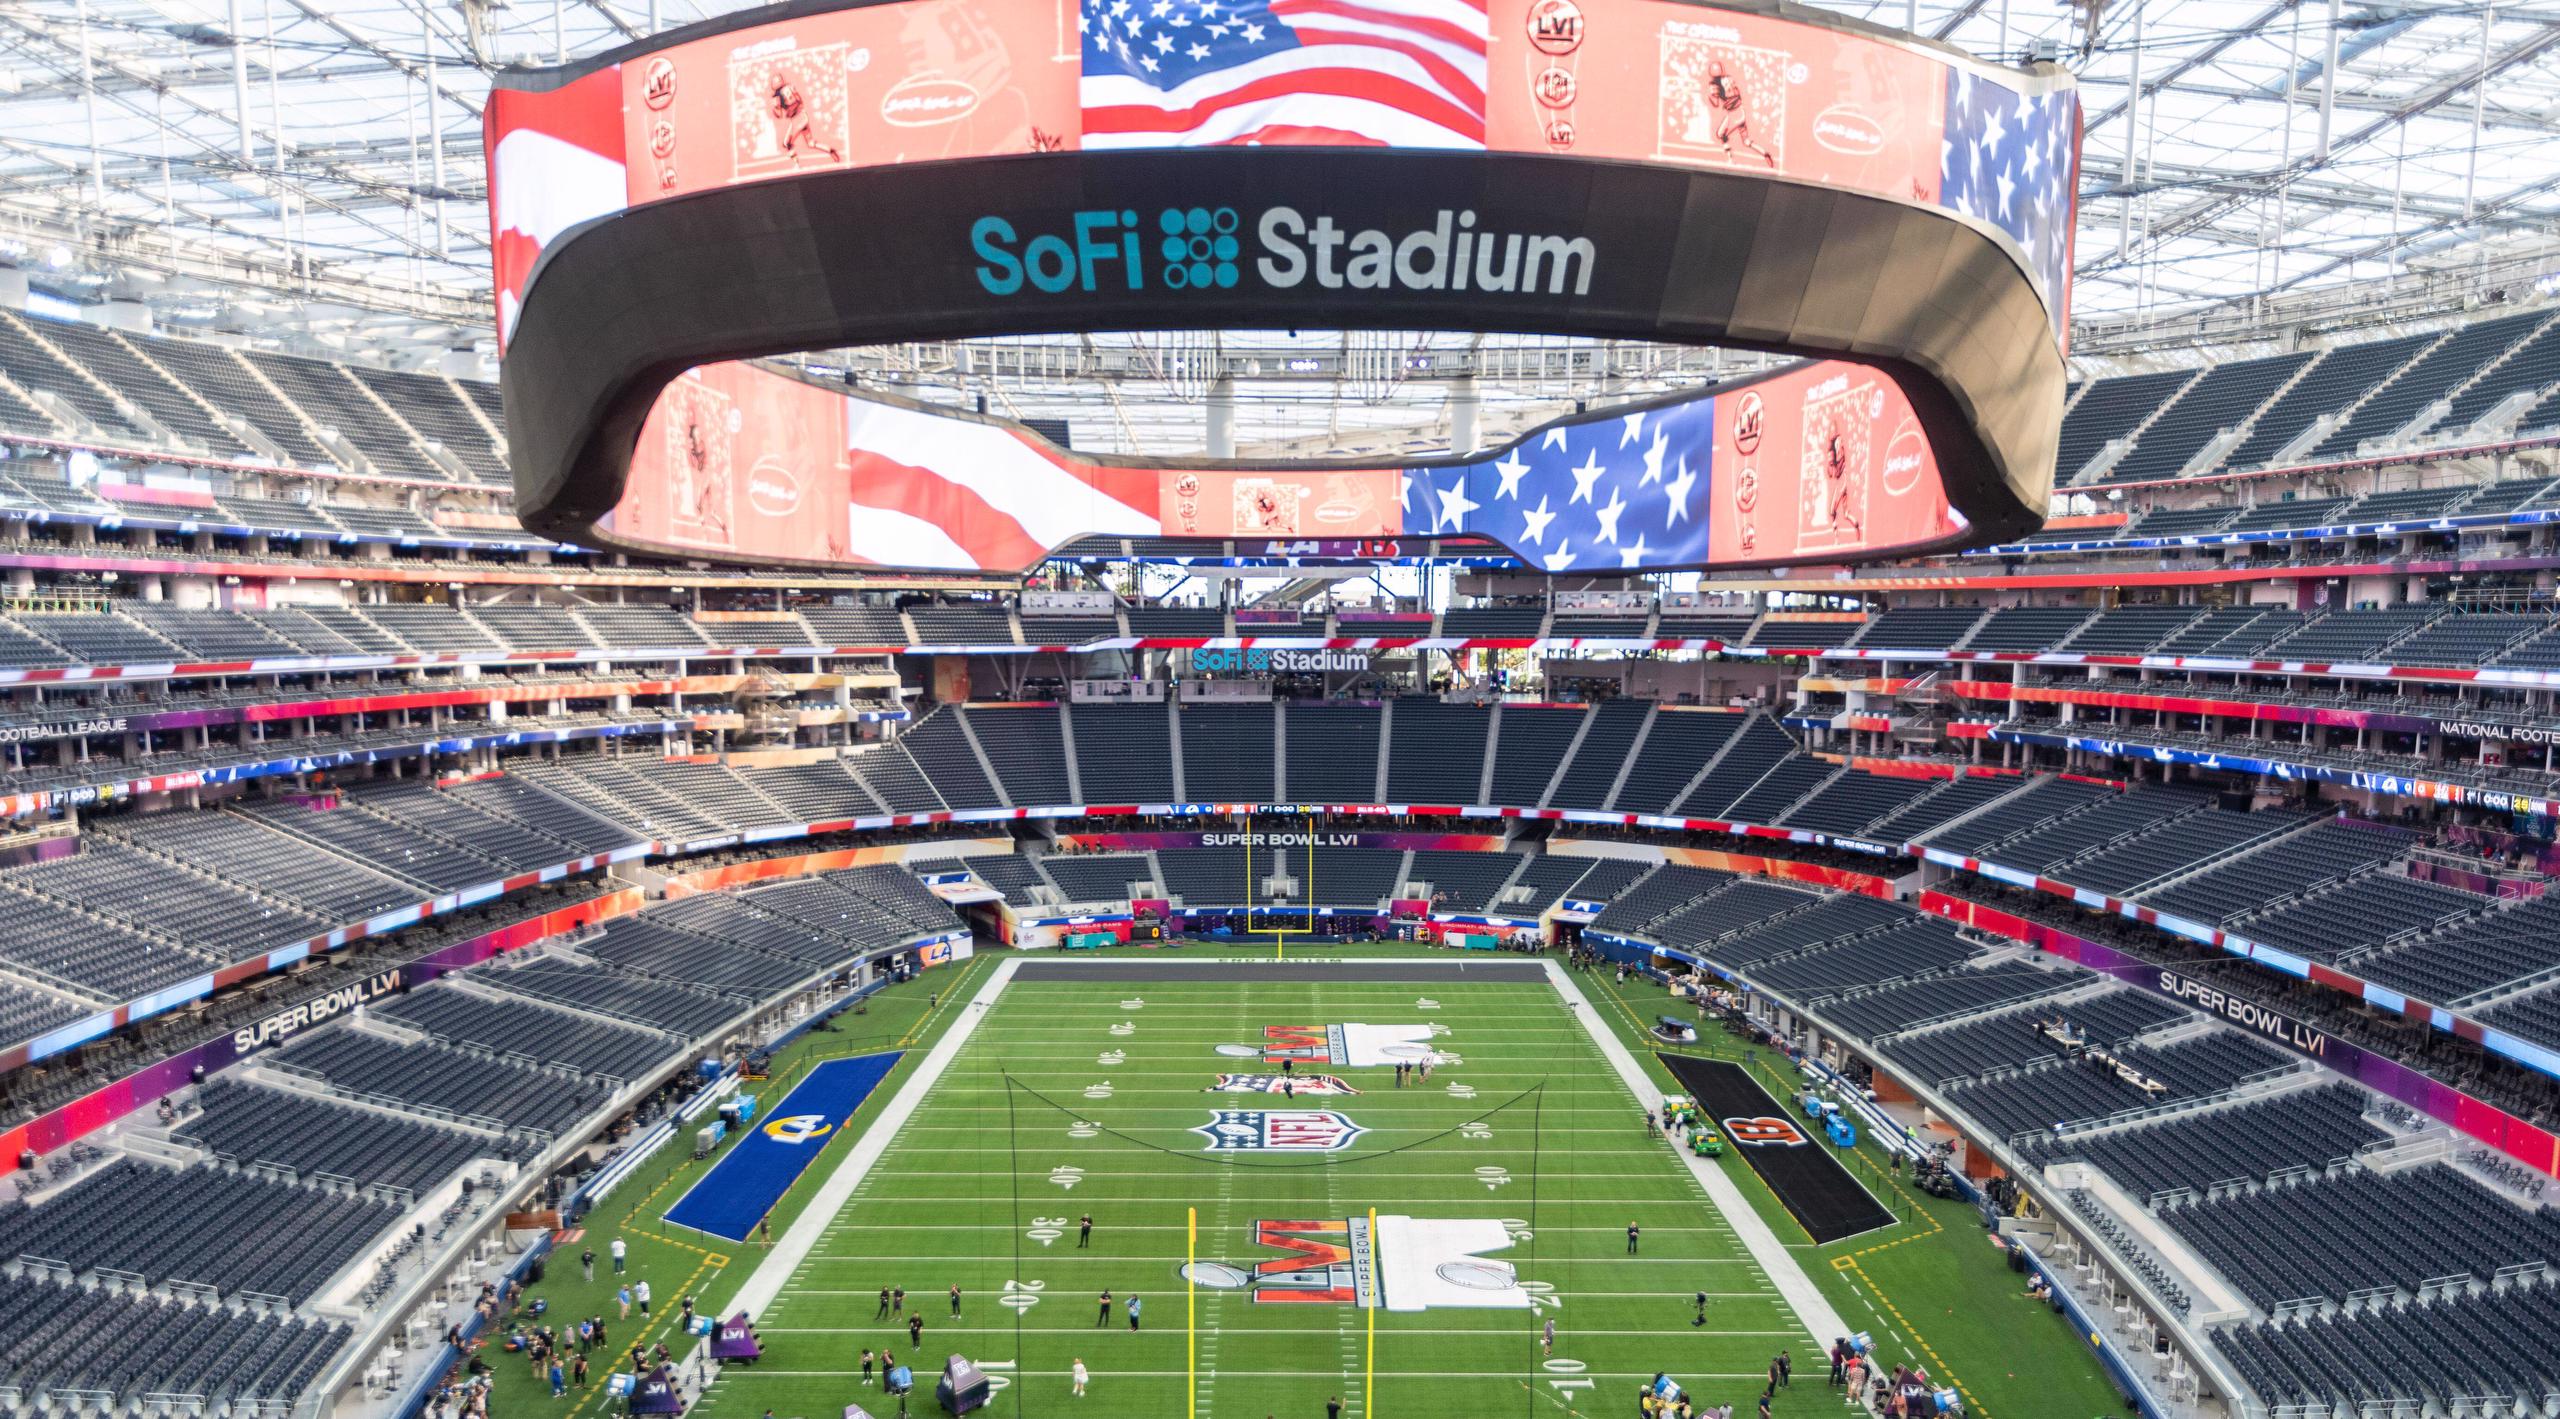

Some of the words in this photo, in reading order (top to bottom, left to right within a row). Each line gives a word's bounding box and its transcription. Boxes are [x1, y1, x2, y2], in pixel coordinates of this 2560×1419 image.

[1537, 17, 1574, 36] LVI
[971, 209, 1144, 295] SoFi
[1257, 206, 1596, 296] Stadium
[1192, 648, 1242, 671] SoFi
[1272, 649, 1368, 671] Stadium
[69, 719, 127, 735] LEAGUE
[2440, 721, 2509, 739] NATIONAL
[1202, 834, 1265, 846] SUPER
[1269, 834, 1326, 846] BOWL
[1330, 834, 1358, 846] LVI
[234, 1006, 310, 1054] SUPER
[310, 984, 370, 1022] BOWL
[371, 969, 400, 996] LVI
[2159, 971, 2225, 1014] SUPER
[2227, 997, 2290, 1041] BOWL
[2293, 1024, 2325, 1056] LVI
[1543, 1358, 1596, 1389] 10
